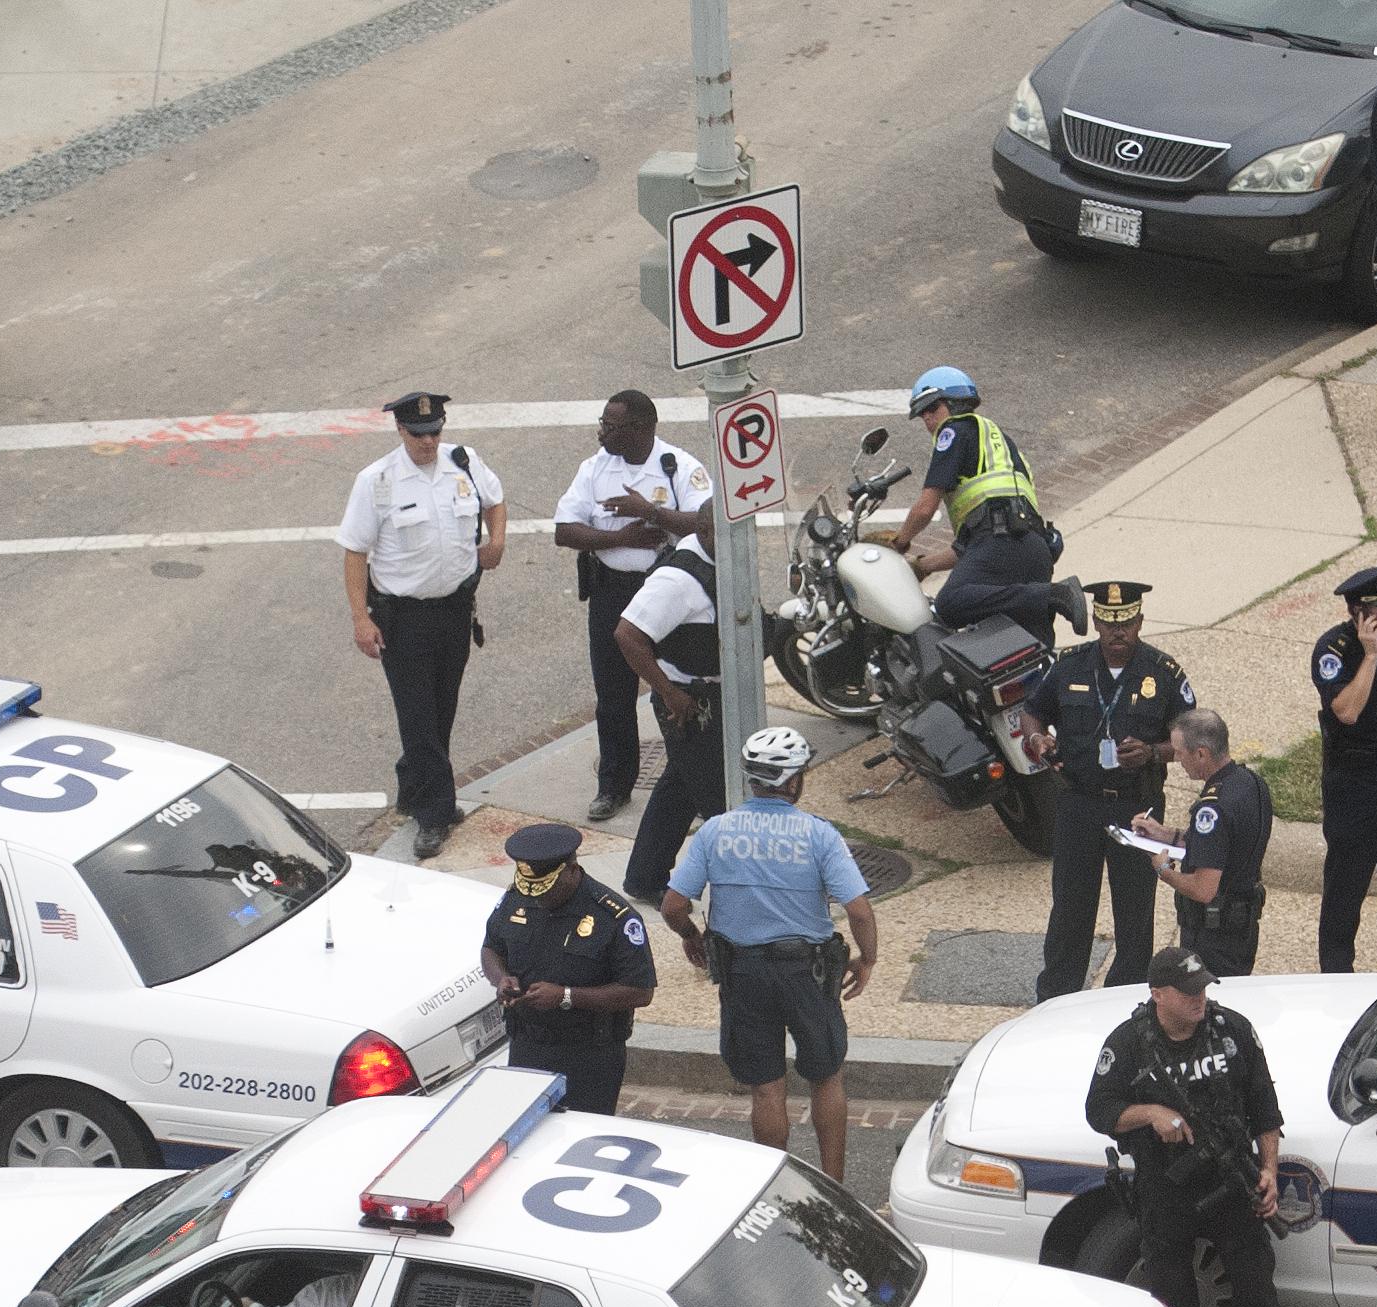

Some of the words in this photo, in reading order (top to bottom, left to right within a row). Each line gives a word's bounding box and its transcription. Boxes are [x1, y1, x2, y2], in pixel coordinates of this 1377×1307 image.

[1105, 214, 1137, 238] FIRE
[155, 798, 202, 828] 1196
[718, 810, 813, 838] METROPOLITAN
[717, 834, 810, 865] POLICE
[231, 860, 278, 898] K-9
[417, 986, 457, 1017] UNITED
[454, 965, 484, 995] STATE
[178, 1072, 316, 1102] 202-228-2800
[522, 1135, 690, 1233] CP
[733, 1201, 780, 1244] 11106
